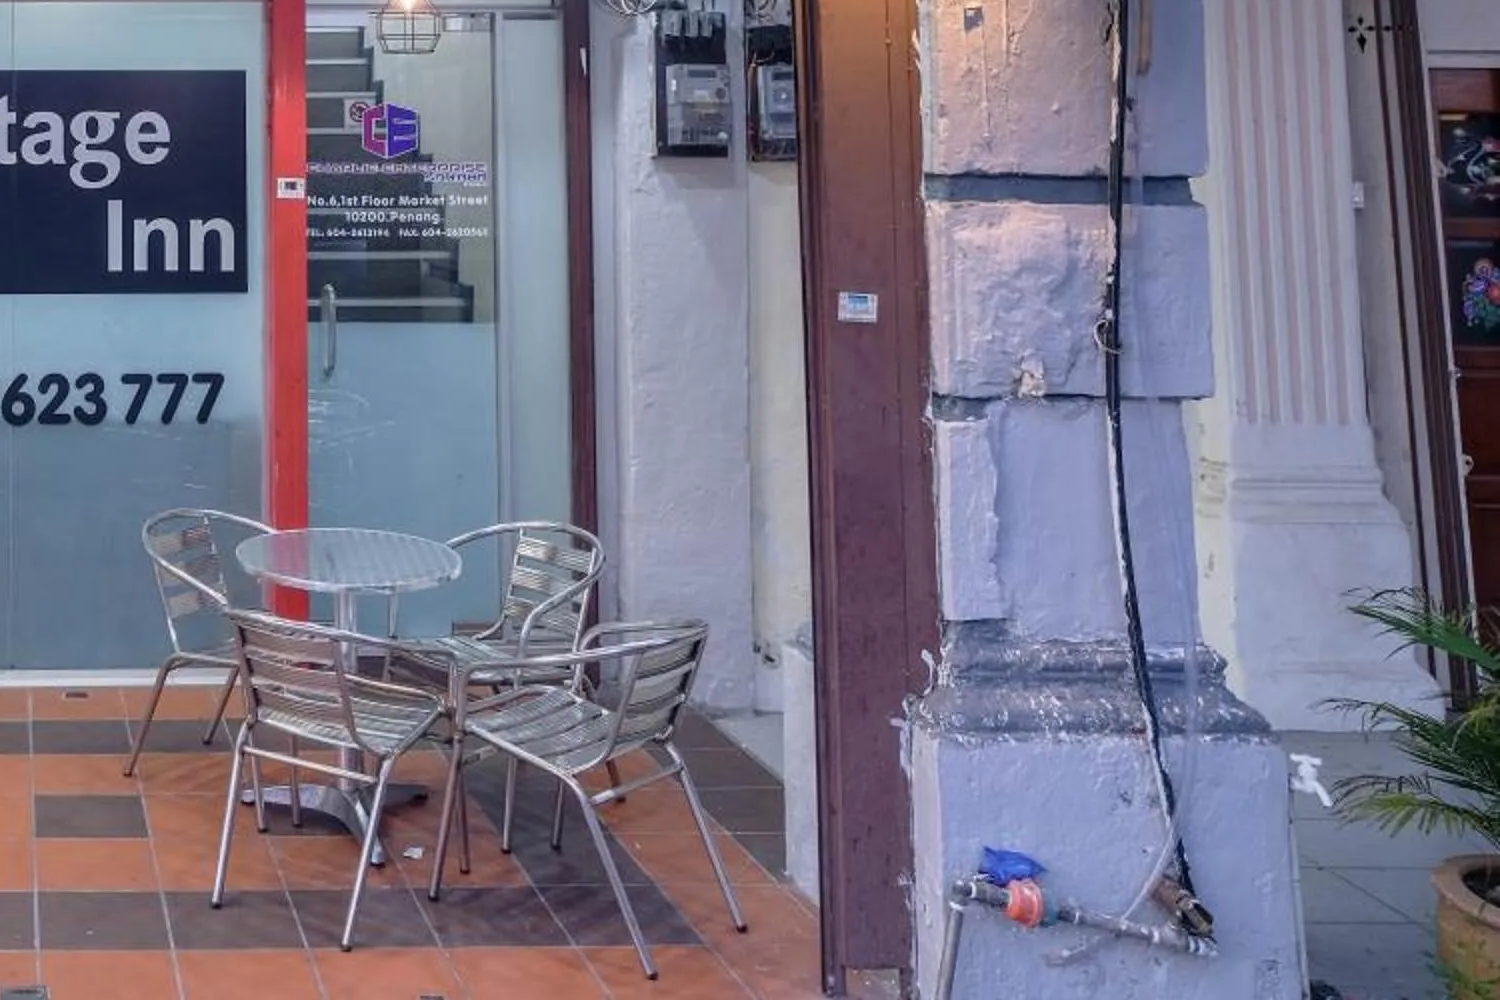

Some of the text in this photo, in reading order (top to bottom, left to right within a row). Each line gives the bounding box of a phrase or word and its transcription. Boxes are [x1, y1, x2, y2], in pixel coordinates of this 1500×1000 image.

[361, 195, 395, 207] Floor
[399, 195, 445, 207] Market
[449, 195, 488, 206] Street
[107, 199, 235, 272] Inn
